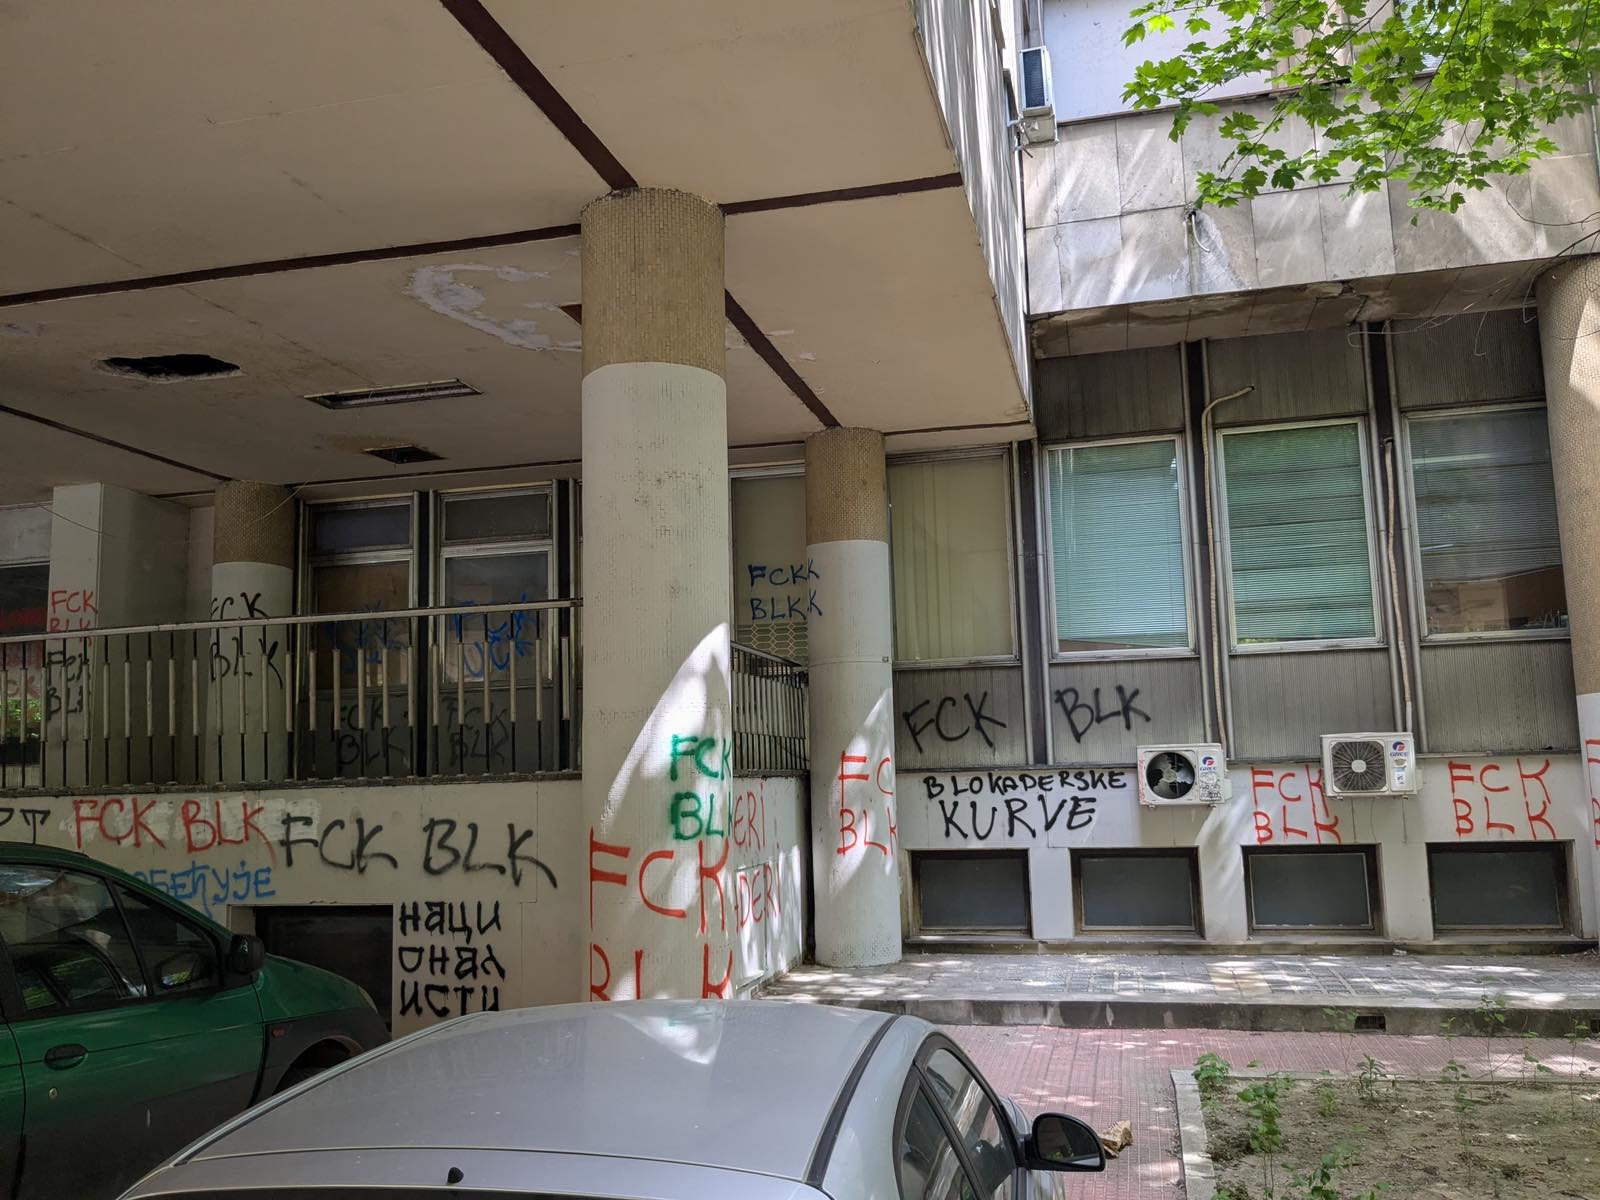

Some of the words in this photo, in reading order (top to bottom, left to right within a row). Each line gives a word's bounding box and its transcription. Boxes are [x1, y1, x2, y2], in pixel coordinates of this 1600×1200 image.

[51, 589, 98, 614] FCK
[903, 691, 1006, 753] FCK
[1055, 685, 1151, 743] BLK
[671, 734, 732, 782] FCK
[1449, 758, 1551, 804] FCK
[923, 771, 1127, 799] BLOKADERSKE
[1251, 765, 1329, 818] FCK
[73, 798, 166, 849] FCK
[181, 799, 277, 870] BLK
[670, 791, 732, 840] BLK
[837, 807, 898, 856] BLK
[939, 794, 1096, 840] KURVE
[1252, 805, 1341, 844] BLK
[1452, 796, 1556, 840] BLK
[279, 812, 398, 875] FCK
[423, 817, 558, 889] BLK
[589, 826, 730, 933] FCK
